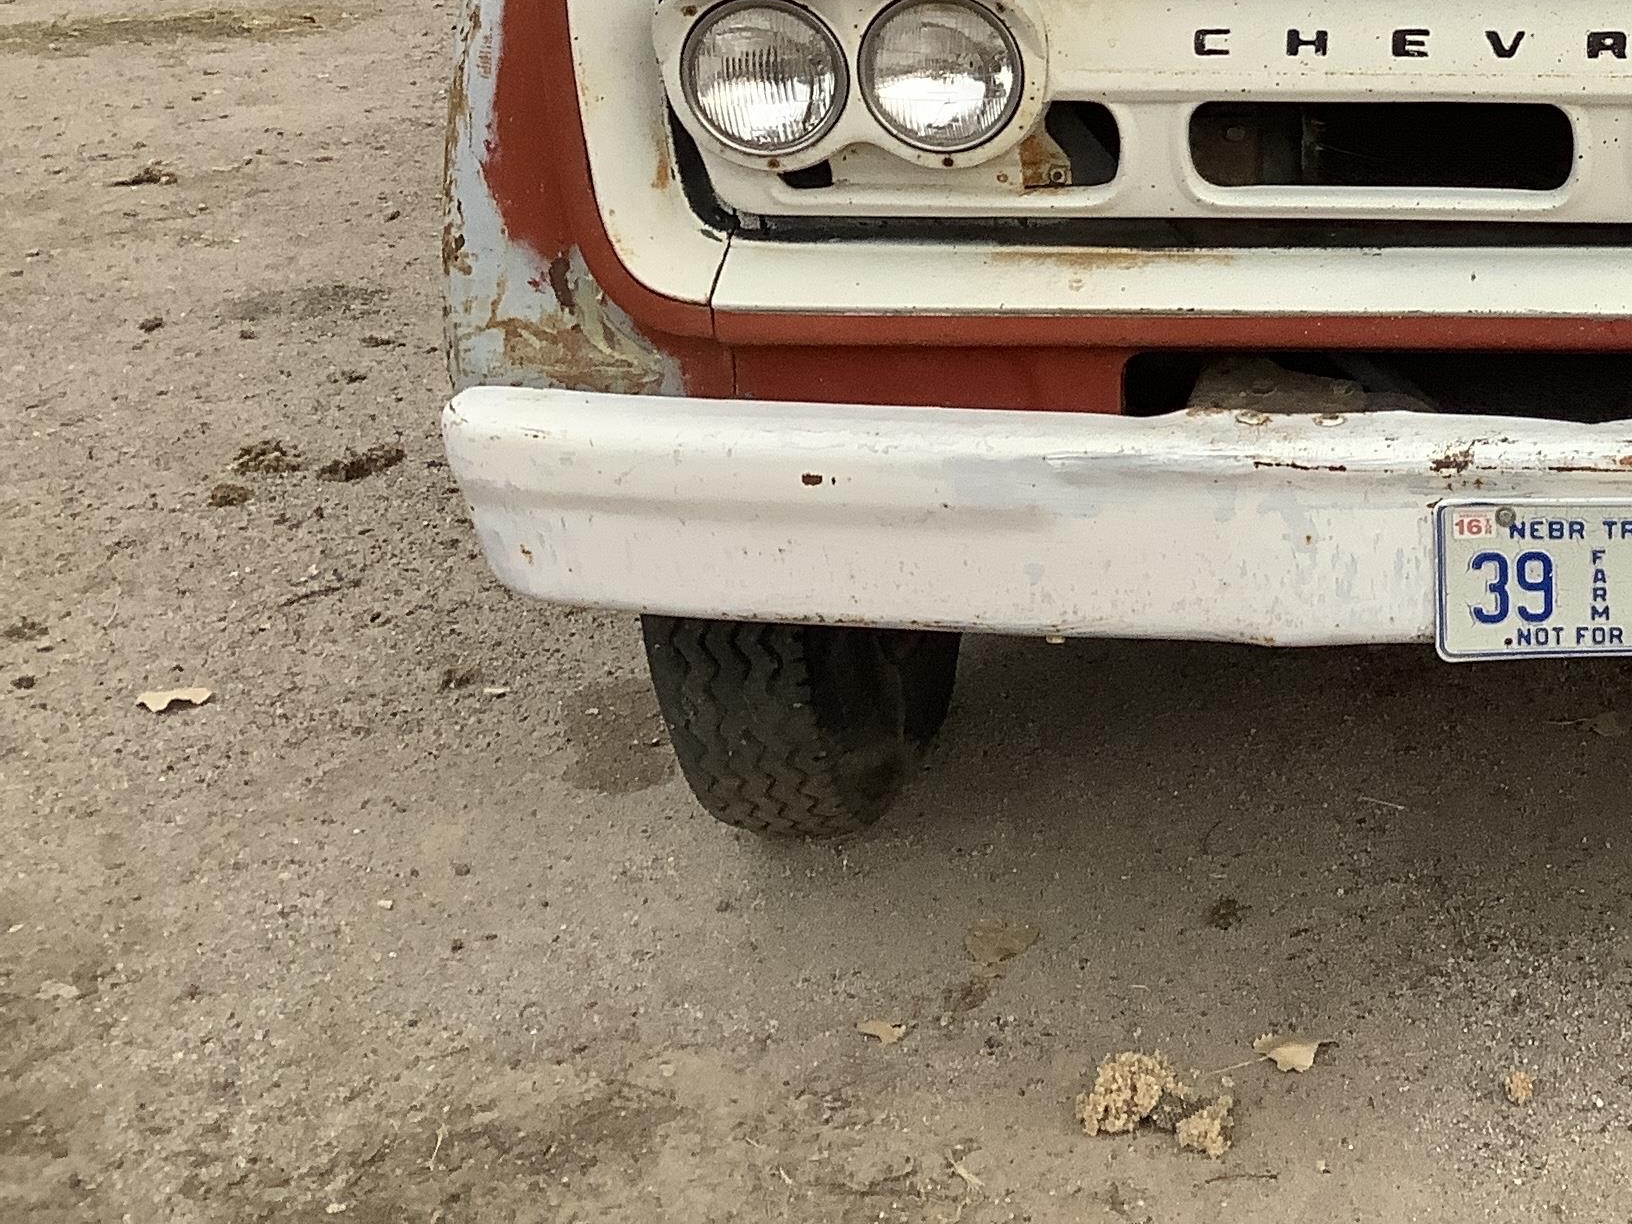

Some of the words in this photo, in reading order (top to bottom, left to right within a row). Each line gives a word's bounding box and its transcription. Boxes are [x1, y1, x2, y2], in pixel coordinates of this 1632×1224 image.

[1455, 519, 1482, 536] 16
[1508, 521, 1585, 540] NEBR
[1471, 551, 1554, 624] 39
[1591, 550, 1610, 621] FARM
[1517, 626, 1563, 646] NOT
[1577, 626, 1623, 645] FOR
